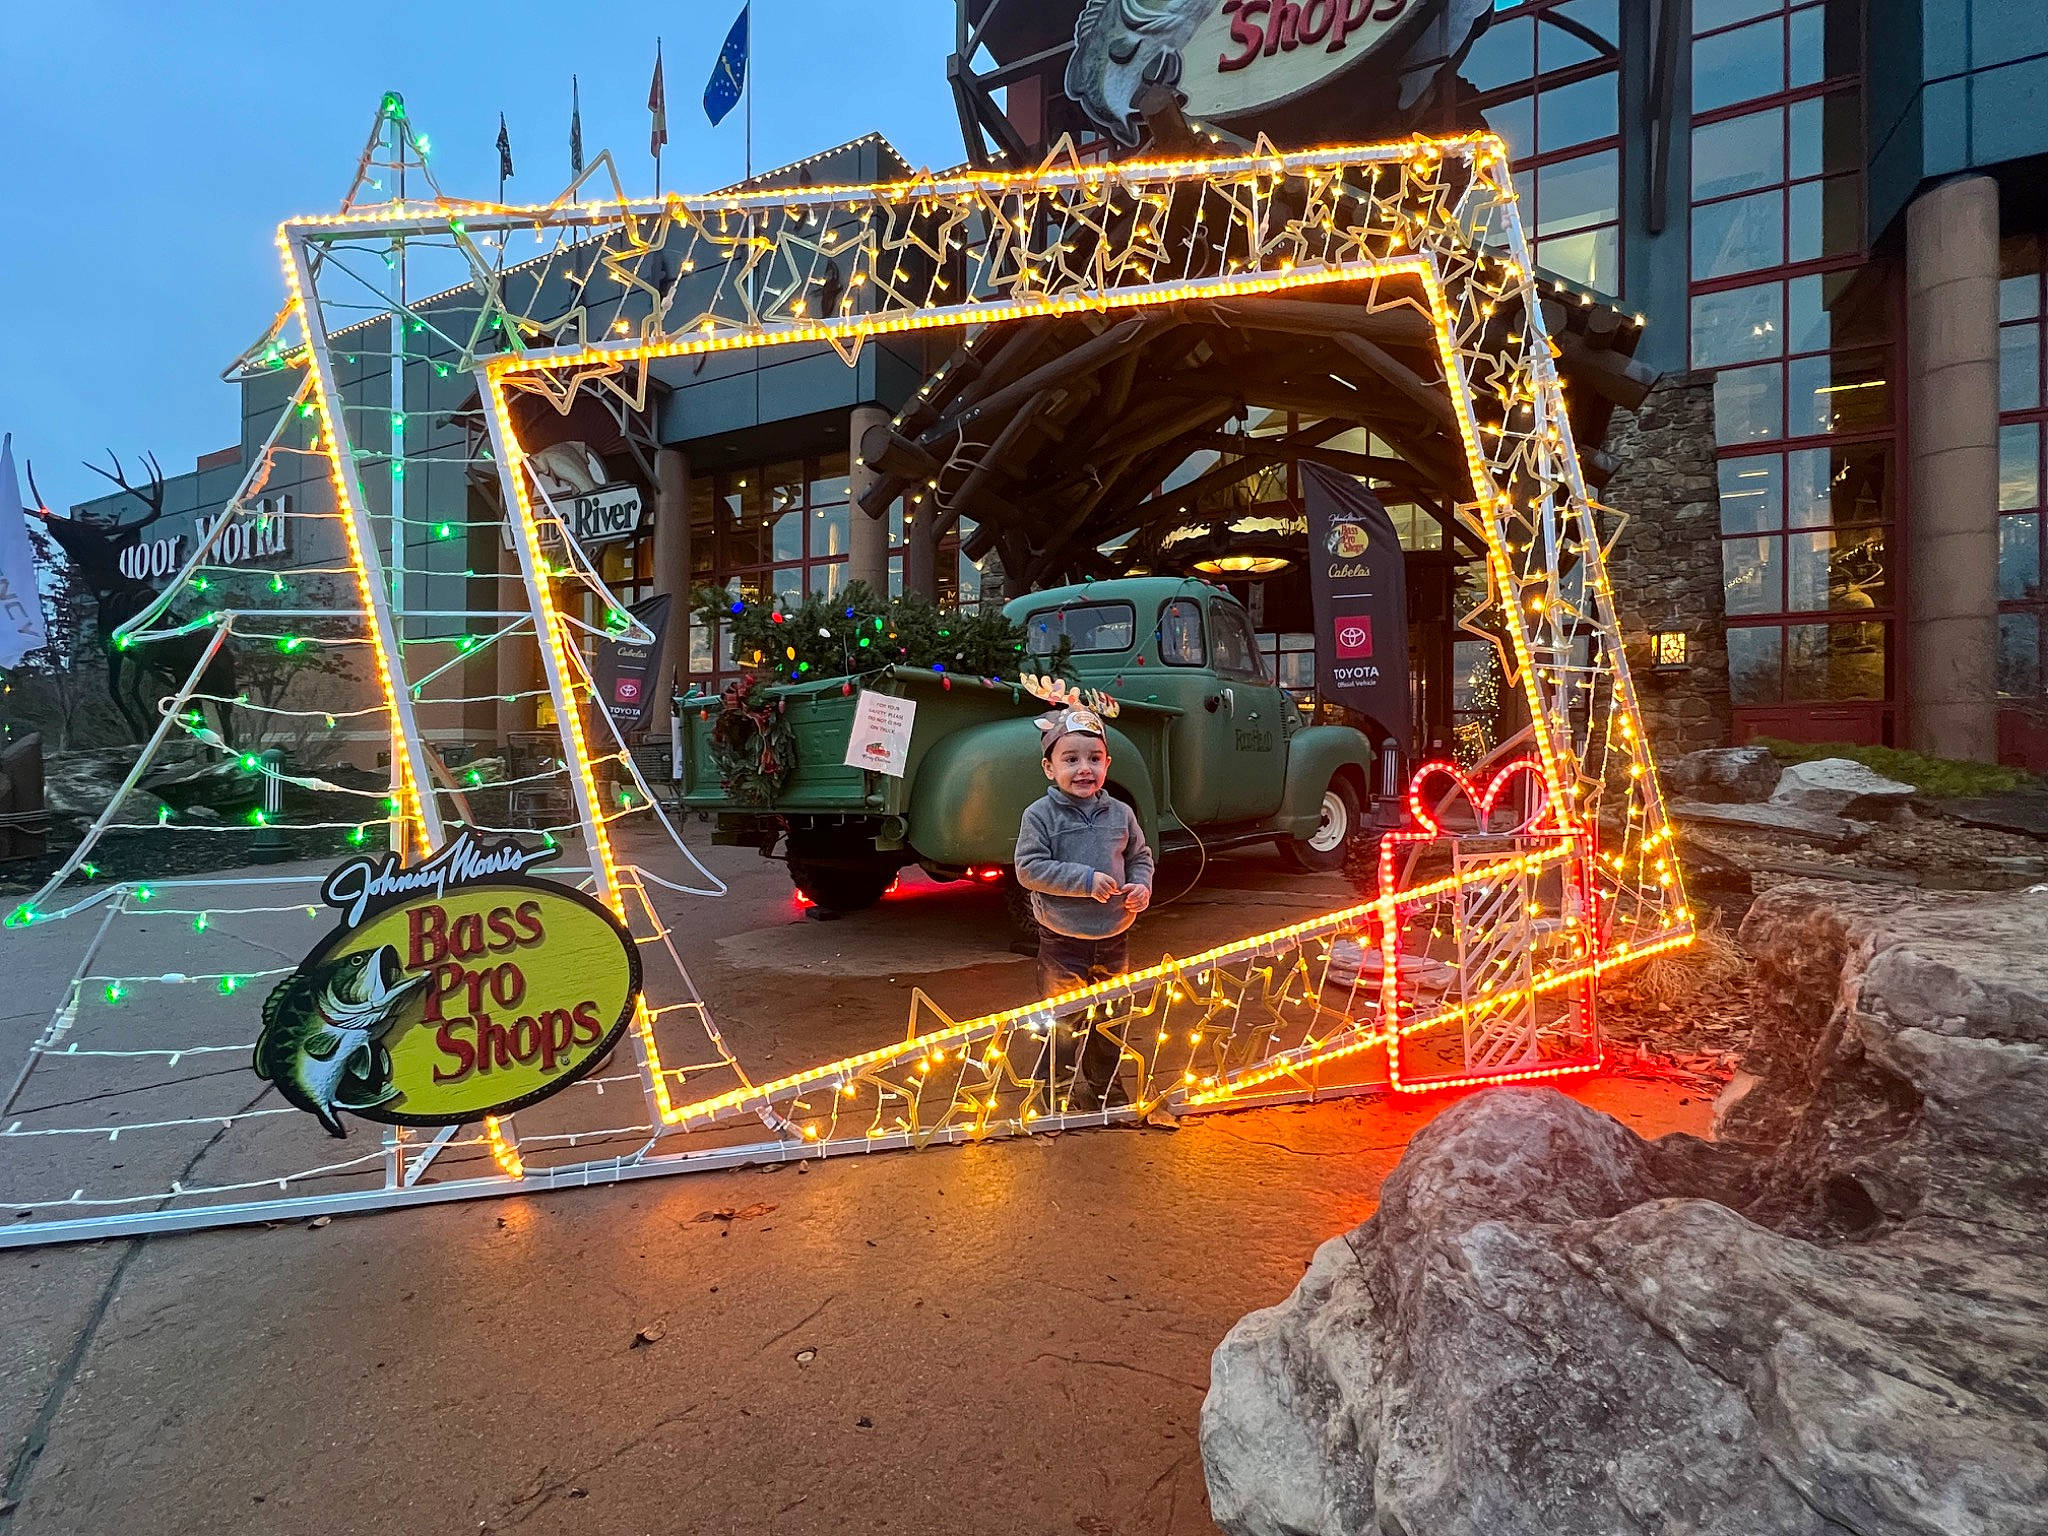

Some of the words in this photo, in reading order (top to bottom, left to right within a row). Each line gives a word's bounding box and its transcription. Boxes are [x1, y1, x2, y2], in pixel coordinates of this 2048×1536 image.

[195, 494, 287, 566] World
[574, 497, 638, 537] River
[1333, 666, 1380, 680] TOYOTA
[609, 706, 641, 716] TOYOTA
[329, 857, 447, 928] Johnny
[449, 831, 557, 883] Morris
[406, 900, 546, 971] Bass
[424, 961, 526, 1024] Pro
[432, 1000, 602, 1083] Shops
